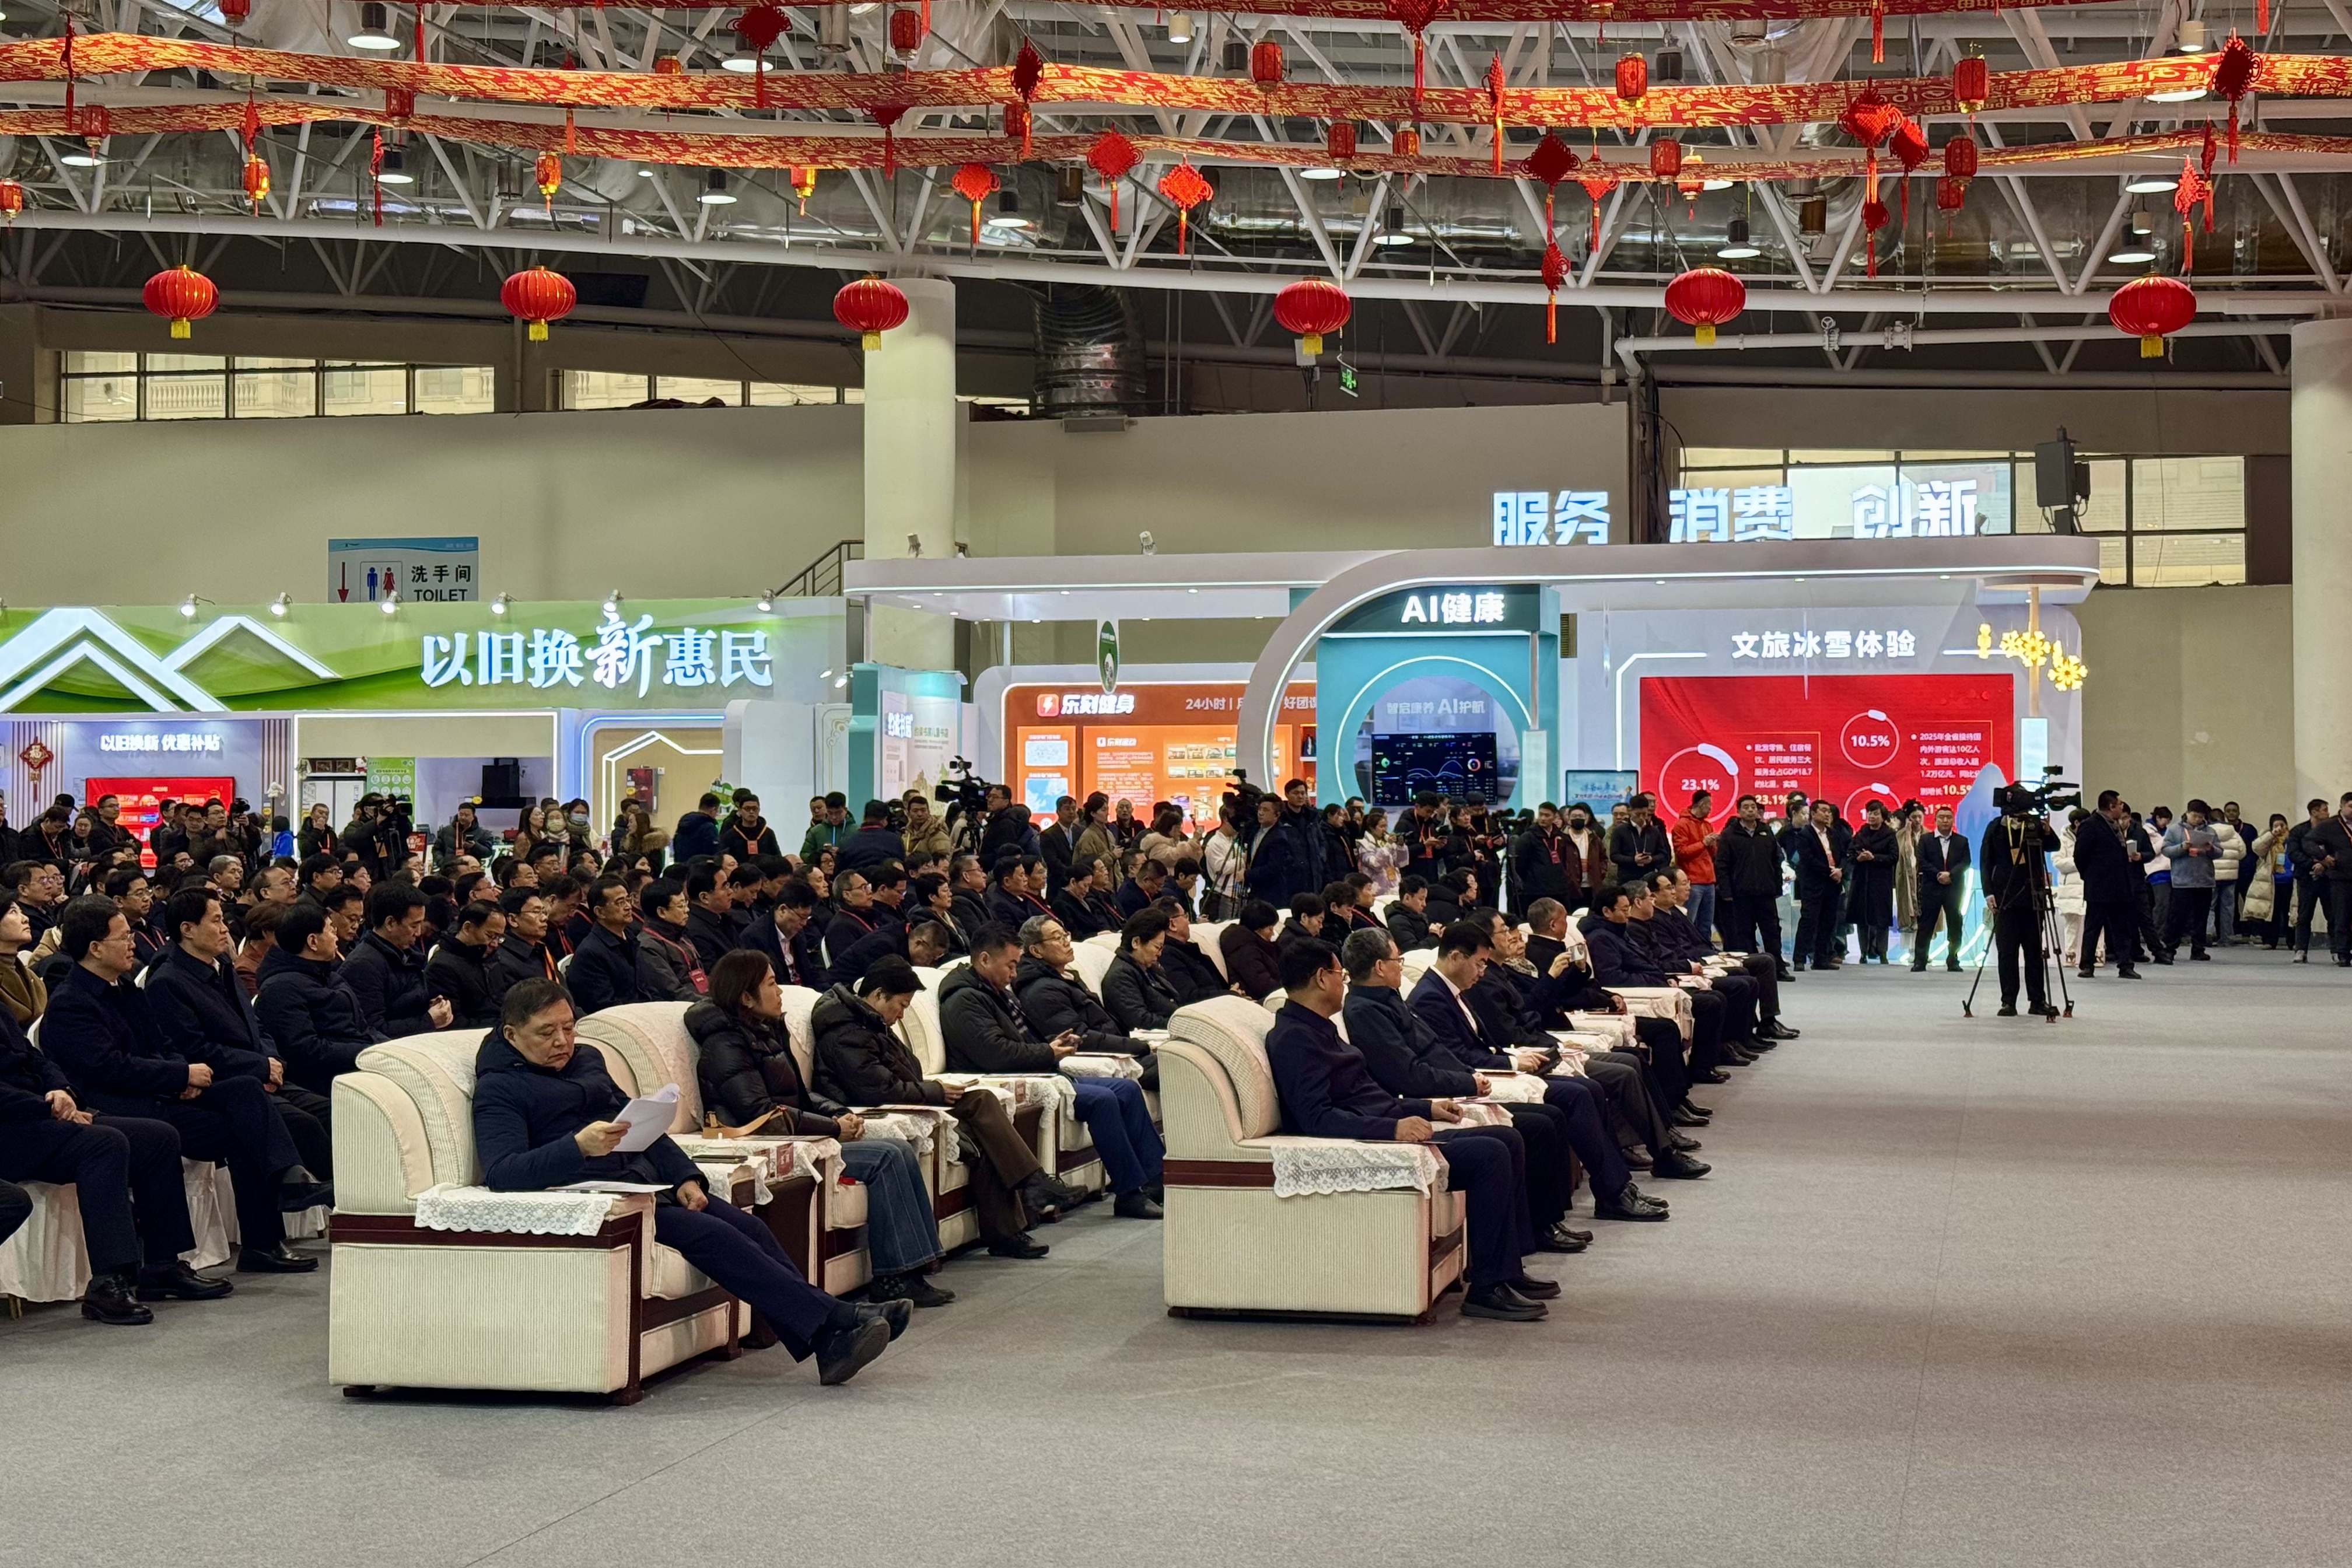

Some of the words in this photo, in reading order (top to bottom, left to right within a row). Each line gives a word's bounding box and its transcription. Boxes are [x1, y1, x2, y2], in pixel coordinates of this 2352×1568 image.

[1493, 489, 1611, 546] 服务
[1669, 485, 1794, 544] 消费
[1852, 480, 1978, 539] 创新
[411, 564, 471, 583] 洗手间
[413, 589, 468, 601] TOILET
[1401, 592, 1505, 624] AI健康
[1731, 629, 1916, 659] 文旅冰雪体验
[420, 608, 774, 699] 以旧换新惠民
[1060, 694, 1135, 714] 乐刻健身
[1185, 697, 1226, 710] 24小时
[1437, 698, 1485, 715] AI护航
[100, 734, 159, 751] 以旧换新
[161, 733, 220, 751] 优惠补贴
[1850, 735, 1891, 747] 10.5%
[1681, 779, 1720, 790] 23.1%
